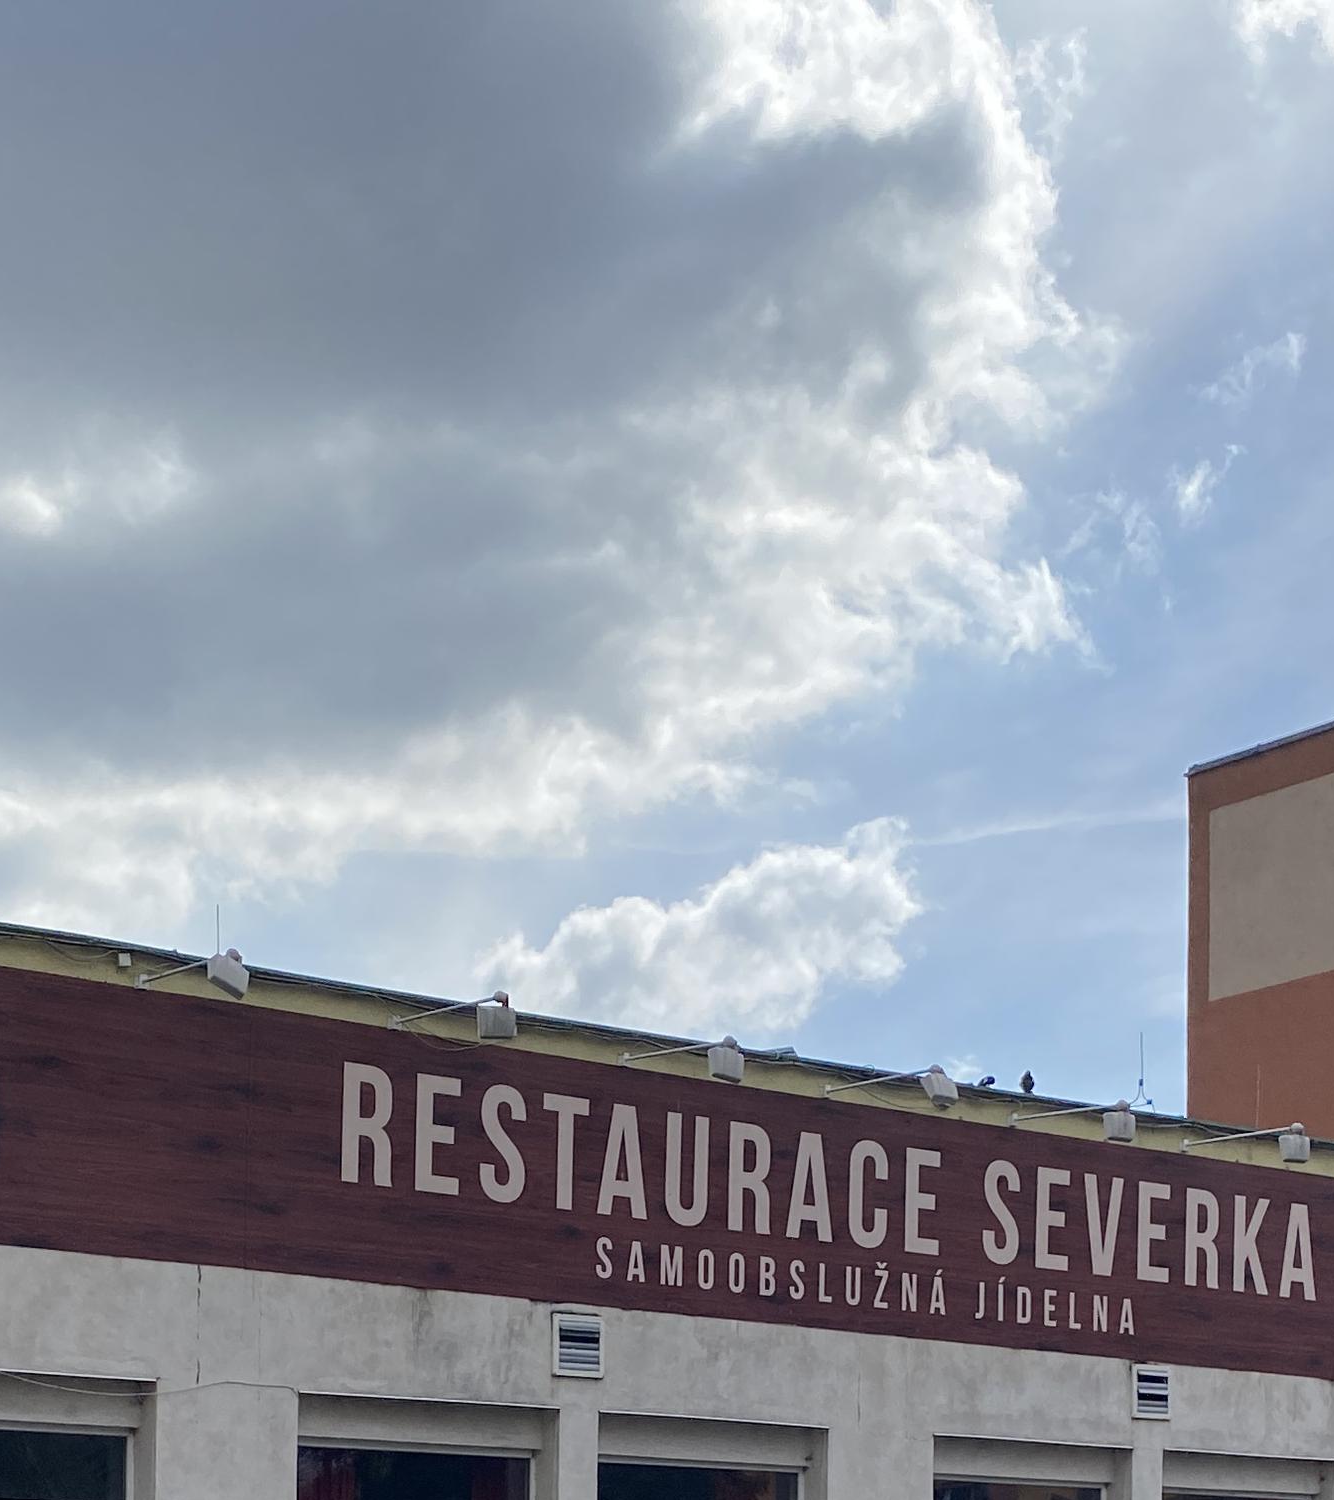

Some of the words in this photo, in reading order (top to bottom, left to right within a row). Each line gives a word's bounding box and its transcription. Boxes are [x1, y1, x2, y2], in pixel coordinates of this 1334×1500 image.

[340, 1061, 941, 1256] RESTAURACE
[982, 1159, 1317, 1301] SEVERKA
[596, 1236, 947, 1316] SAMOOBSLUŽNÁ
[975, 1276, 1136, 1336] JÍDELNA
